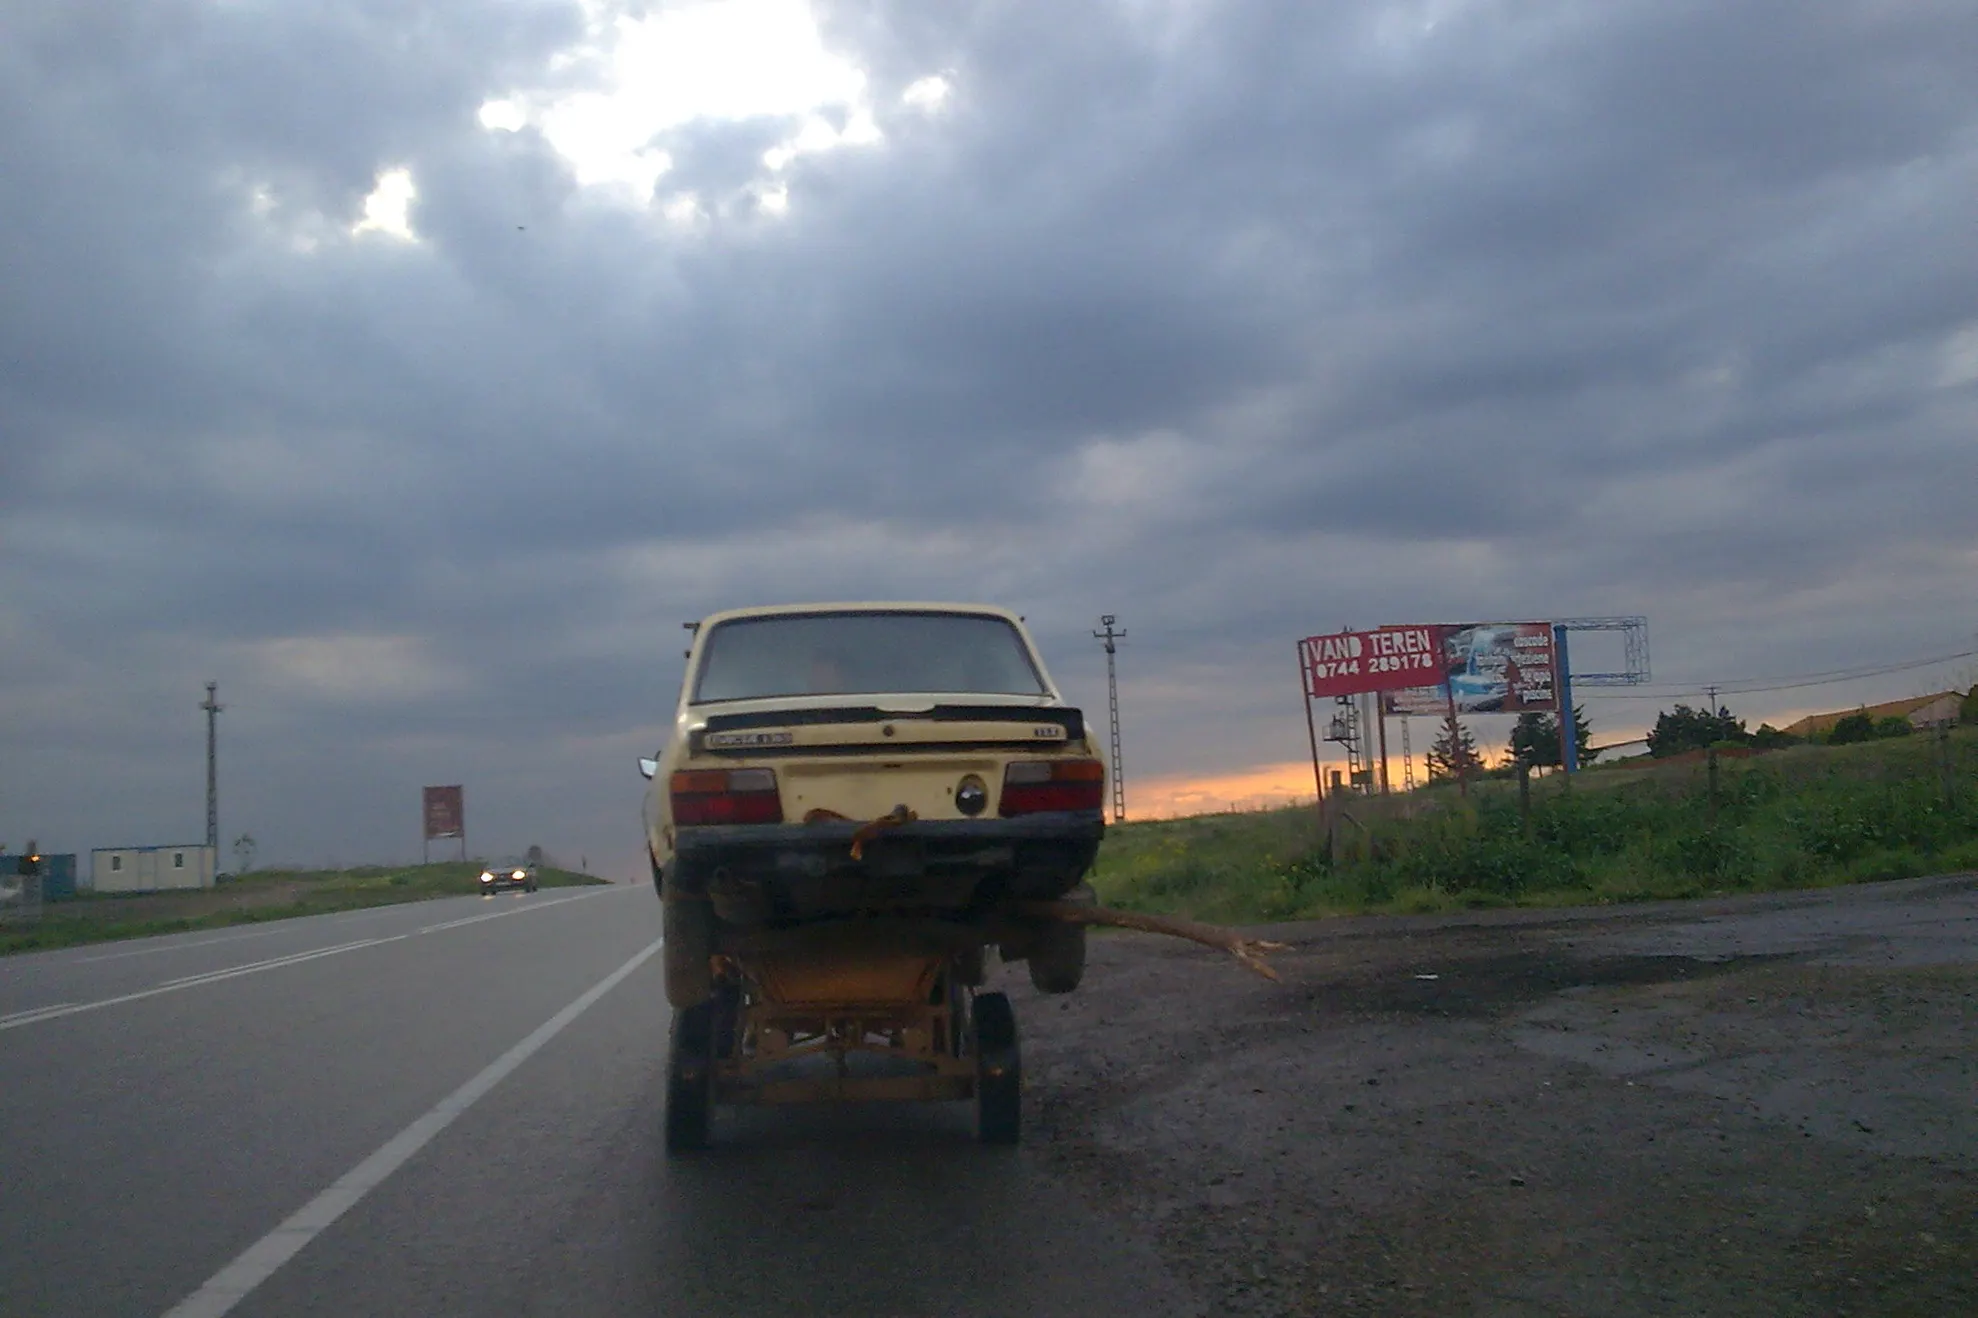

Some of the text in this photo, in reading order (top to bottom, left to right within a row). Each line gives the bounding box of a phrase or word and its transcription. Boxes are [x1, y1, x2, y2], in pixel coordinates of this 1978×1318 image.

[1309, 629, 1431, 662] VAND TEREN
[1316, 653, 1433, 679] 0744 289178
